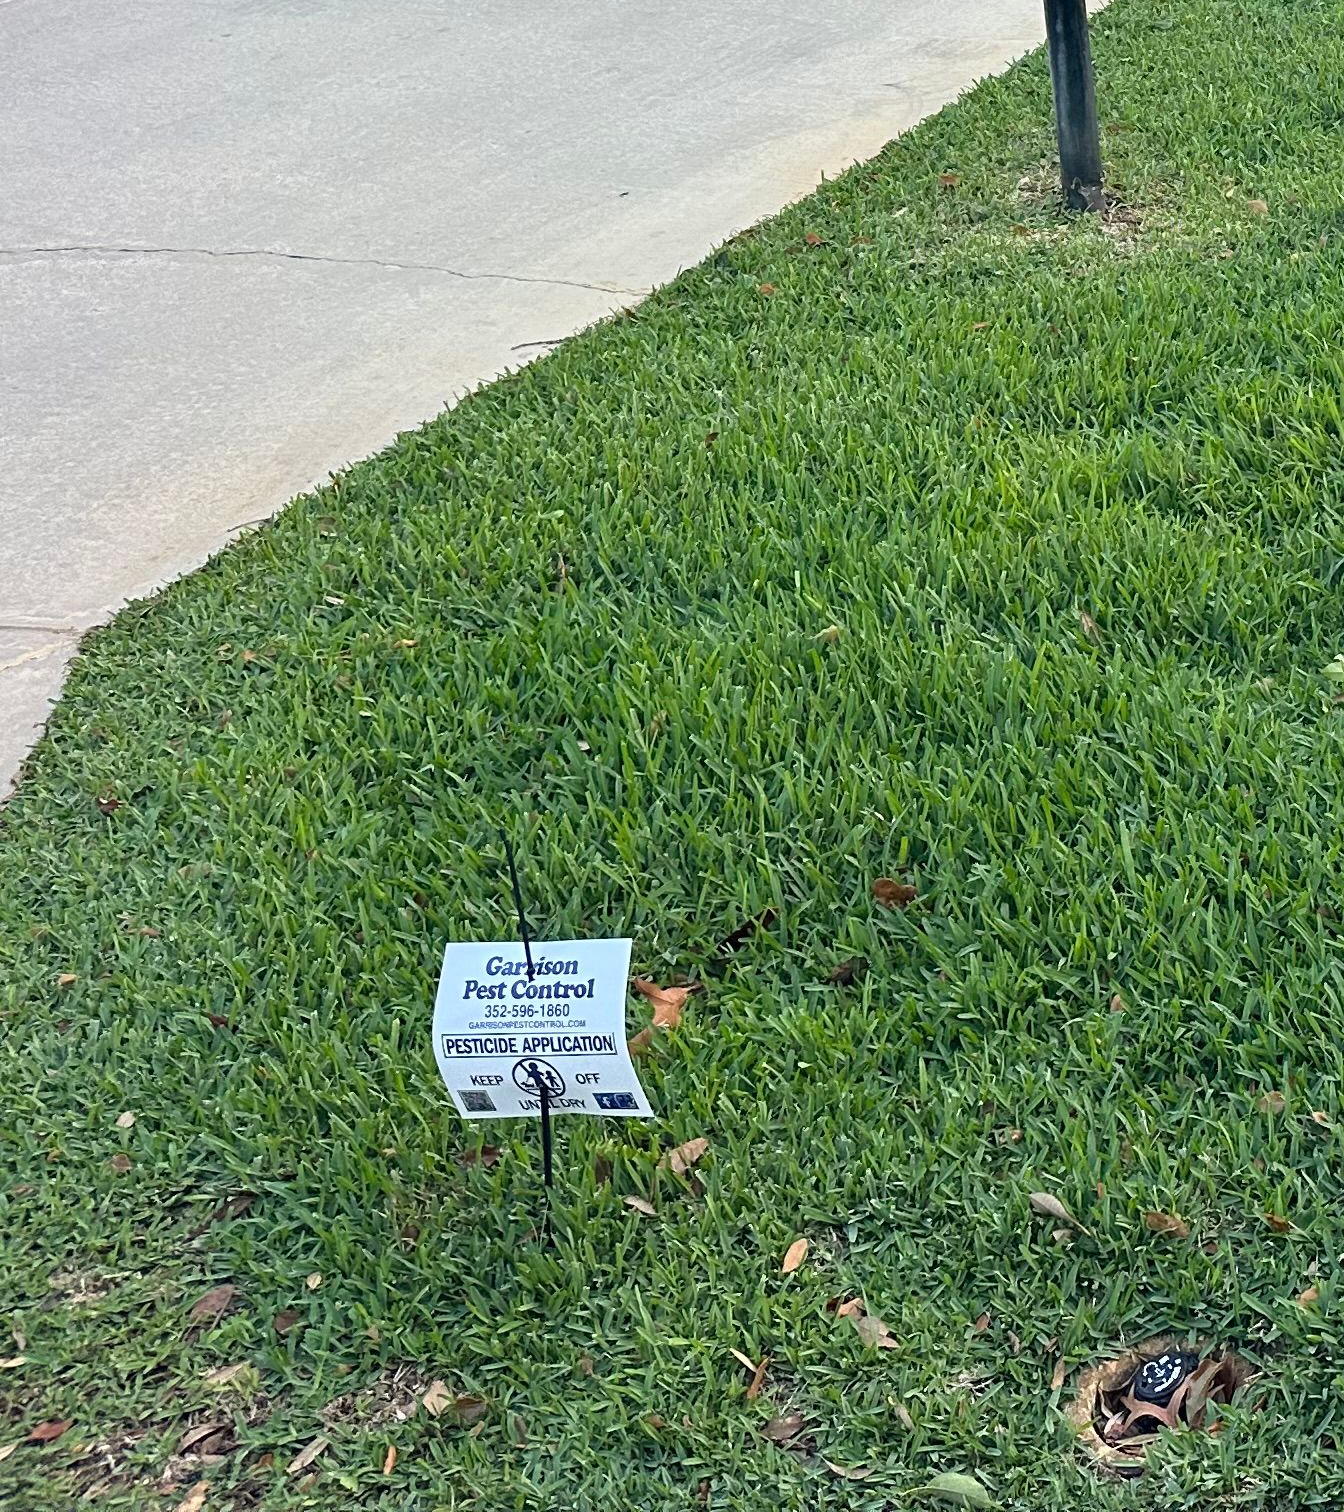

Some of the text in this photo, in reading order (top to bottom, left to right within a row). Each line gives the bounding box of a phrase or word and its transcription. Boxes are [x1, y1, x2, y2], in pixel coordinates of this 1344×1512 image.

[463, 978, 595, 999] Pest Control
[484, 1004, 570, 1018] 352-596-1860
[446, 1035, 614, 1054] PESTICIDE APPLICATION
[470, 1073, 600, 1086] KEEP OFF
[560, 1098, 587, 1109] DRY
